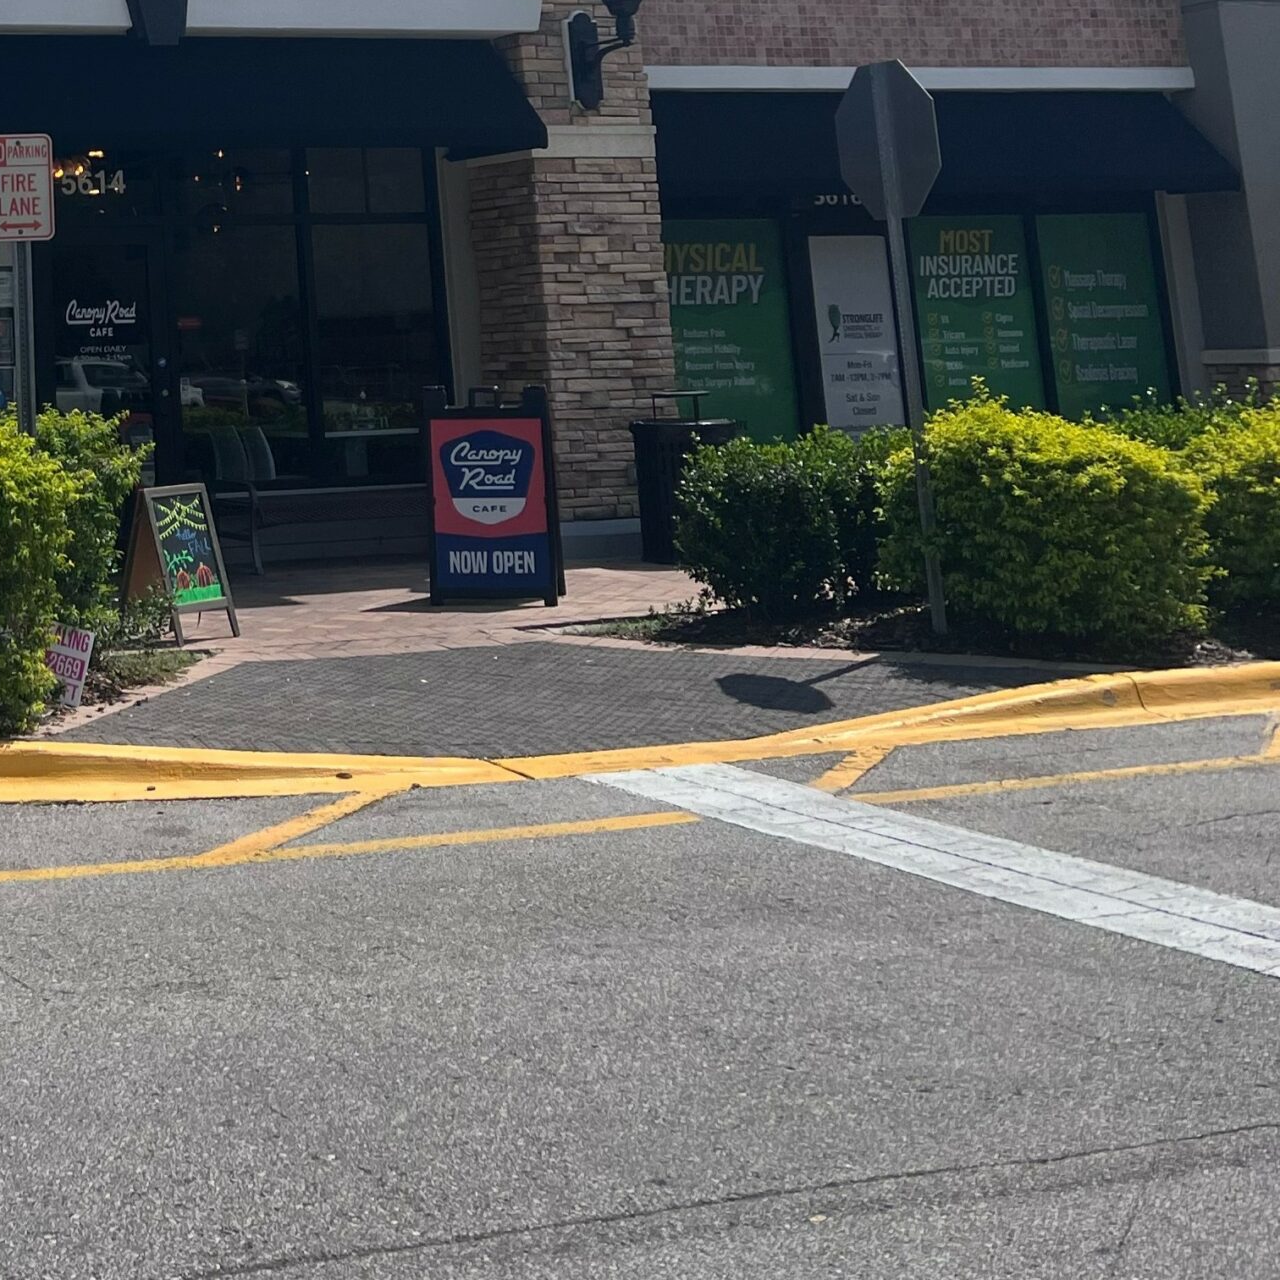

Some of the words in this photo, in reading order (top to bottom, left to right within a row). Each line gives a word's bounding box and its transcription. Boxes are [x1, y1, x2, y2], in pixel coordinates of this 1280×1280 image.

[7, 144, 47, 159] PARKING
[0, 173, 37, 193] FIRE
[61, 169, 126, 196] 5614
[939, 229, 993, 254] MOST
[920, 254, 1018, 276] INSURANCE
[668, 275, 765, 305] HERAPY
[927, 276, 1016, 299] ACCEPTED
[65, 299, 105, 325] Canopy
[104, 299, 137, 324] Road
[842, 313, 884, 324] STRONGLIFE
[89, 327, 114, 337] CAFE
[104, 345, 127, 353] DAILY
[846, 393, 858, 402] Sat
[450, 441, 522, 465] Canopy
[459, 468, 516, 490] Road
[472, 504, 508, 513] CAFE
[187, 537, 212, 558] FALL
[449, 551, 488, 574] NOW
[492, 551, 535, 574] OPEN
[53, 624, 91, 653] ALING
